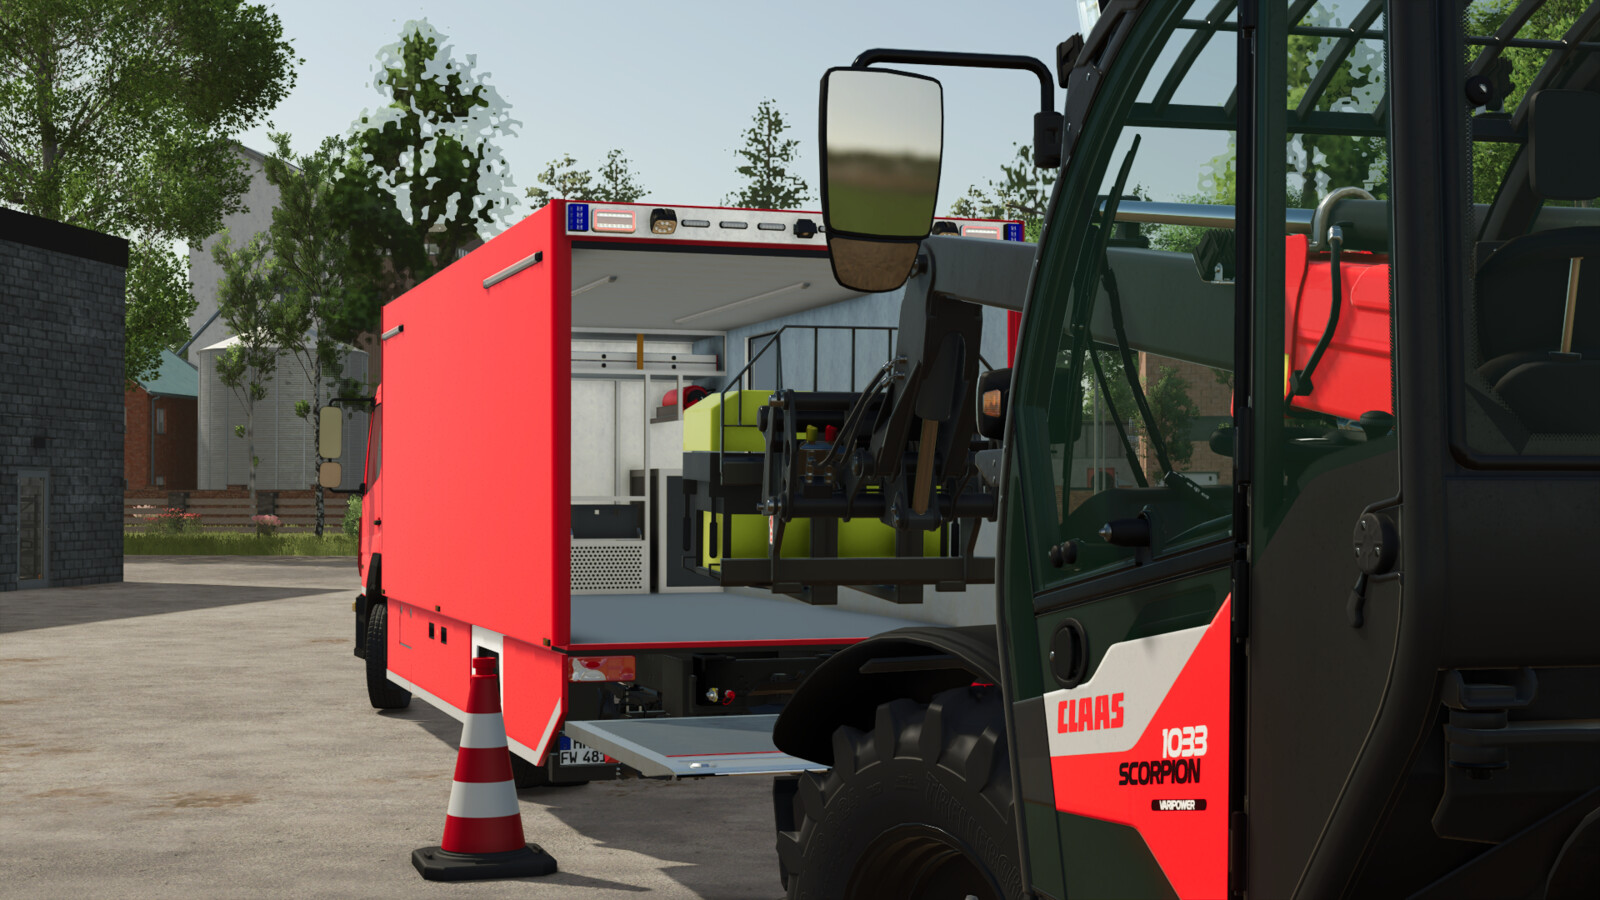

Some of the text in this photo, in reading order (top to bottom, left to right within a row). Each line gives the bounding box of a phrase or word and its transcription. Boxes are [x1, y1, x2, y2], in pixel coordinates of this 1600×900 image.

[1057, 692, 1125, 734] CLAAS
[1162, 725, 1208, 758] 1033
[561, 751, 578, 764] FW
[1118, 758, 1201, 786] SCORPION
[1159, 799, 1196, 811] VARIPOWER
